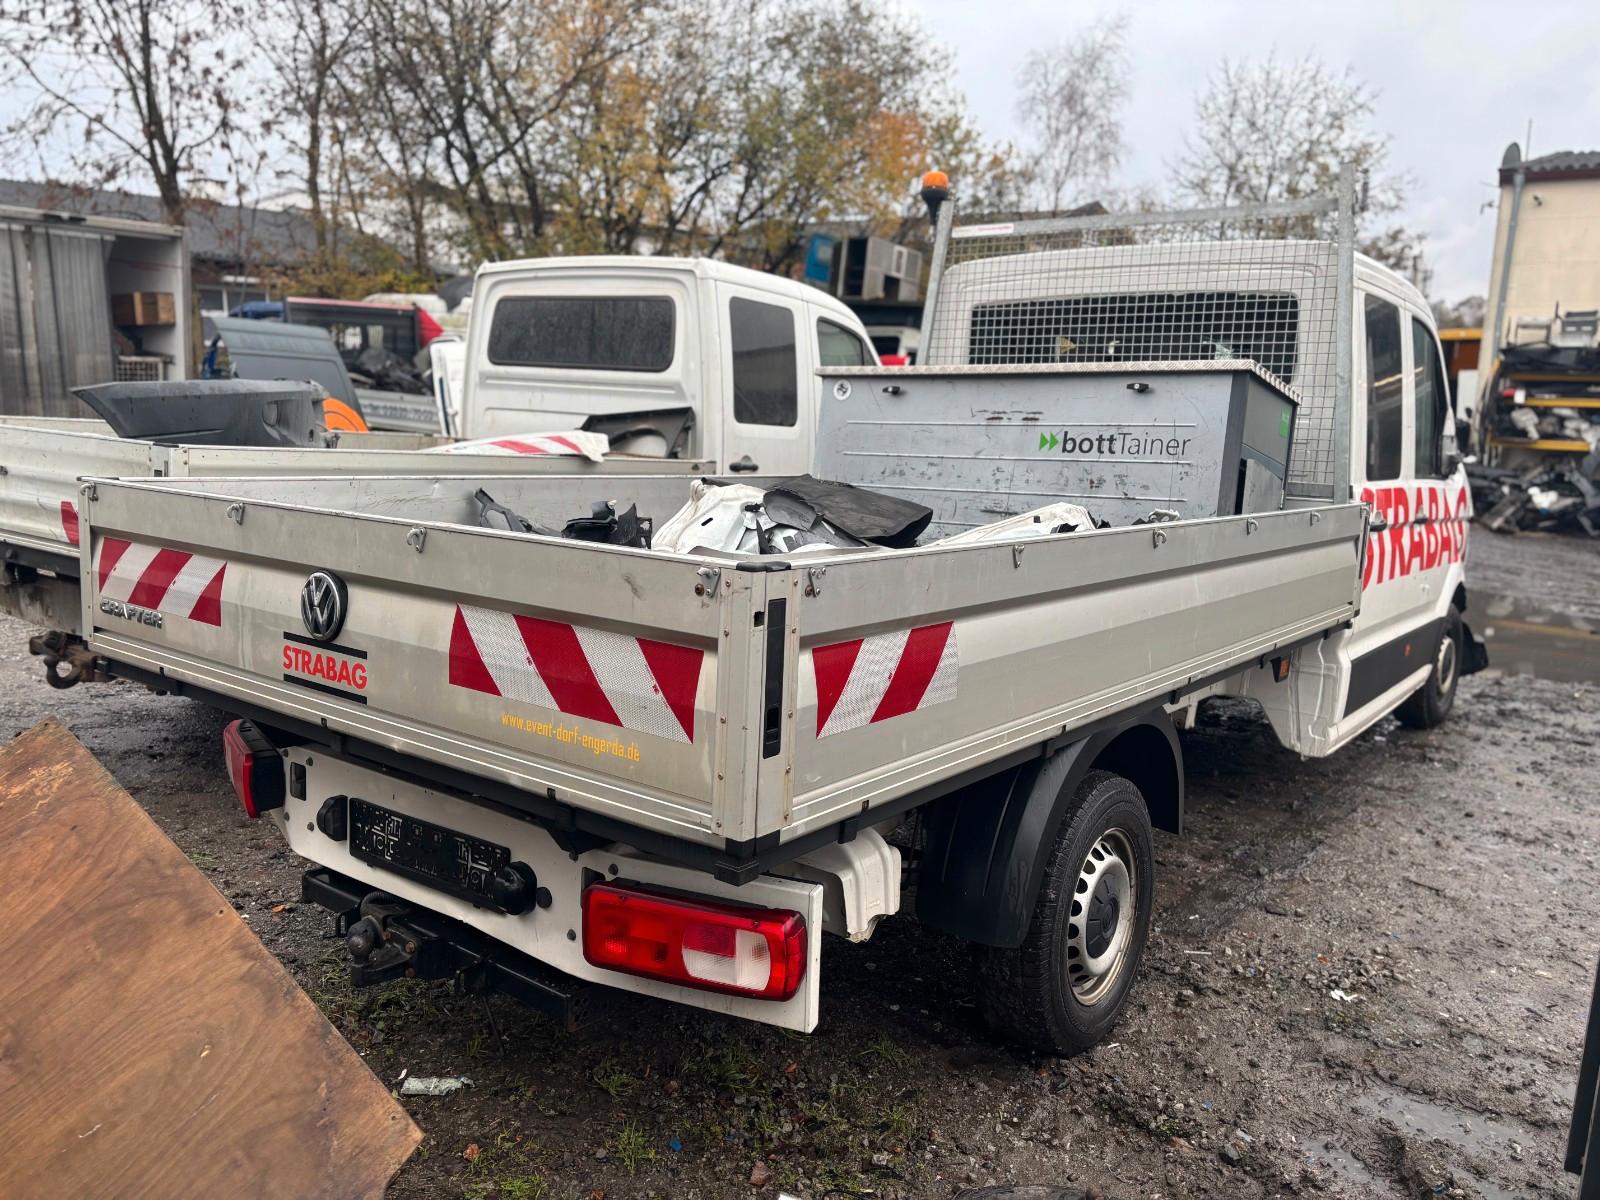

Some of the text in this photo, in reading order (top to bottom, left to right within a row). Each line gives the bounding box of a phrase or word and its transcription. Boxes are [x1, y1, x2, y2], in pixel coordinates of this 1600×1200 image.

[1061, 430, 1192, 456] bottTainer
[100, 599, 163, 629] CRAFTER
[301, 571, 343, 640] VW
[282, 644, 368, 690] STRABAG
[501, 712, 640, 762] www.event-dorf-engerda.de
